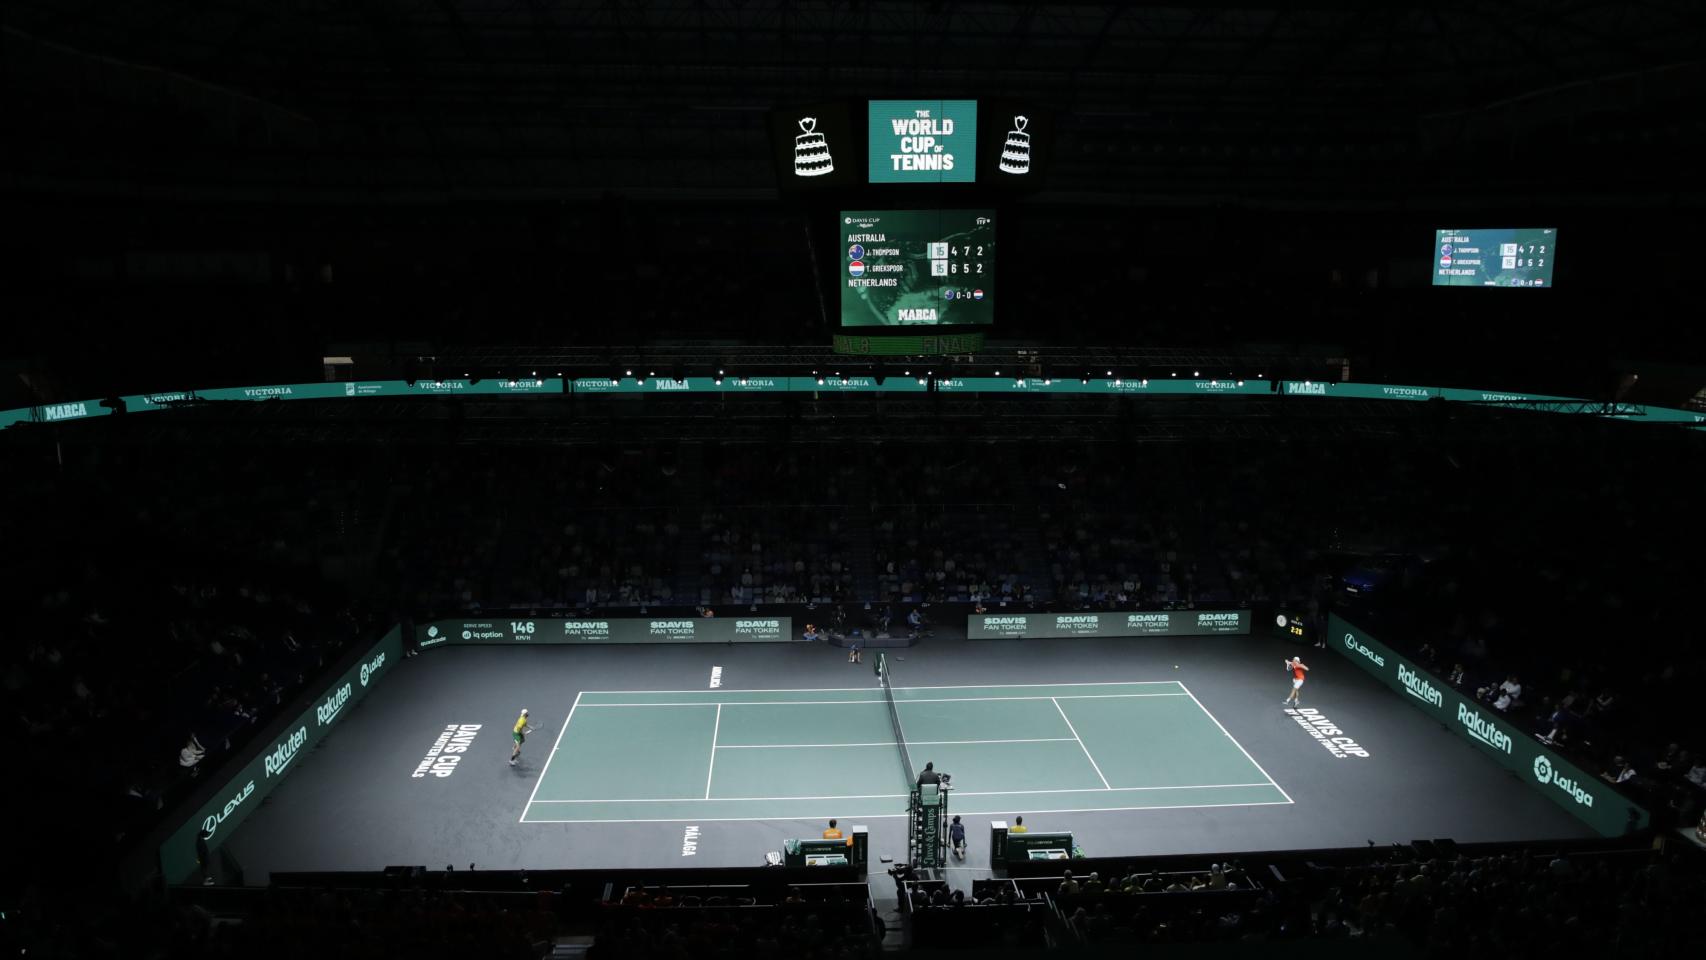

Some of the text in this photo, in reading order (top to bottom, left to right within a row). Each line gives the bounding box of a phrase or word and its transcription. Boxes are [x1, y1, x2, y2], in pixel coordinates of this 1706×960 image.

[915, 110, 930, 118] THE
[892, 119, 954, 135] WORLD
[901, 136, 935, 153] CUP
[891, 154, 954, 171] TENNIS
[848, 234, 886, 242] AUSTRALIA
[873, 248, 900, 256] THOMPSON
[936, 249, 945, 257] 15
[951, 246, 958, 256] 4
[963, 246, 970, 256] 7
[977, 246, 984, 256] 2
[1518, 245, 1525, 253] 4
[1529, 245, 1536, 254] 7
[1539, 245, 1546, 254] 2
[873, 264, 903, 272] GRIEKSPOOR
[936, 265, 945, 274] 15
[951, 263, 957, 273] 6
[963, 263, 970, 273] 5
[976, 263, 983, 273] 2
[1527, 258, 1534, 267] 5
[1538, 258, 1544, 267] 2
[848, 278, 898, 287] NETHERLANDS
[898, 308, 938, 321] MARCA
[499, 380, 542, 389] VITORIA
[655, 379, 690, 390] MARCA
[731, 379, 774, 387] VITORIA
[1288, 381, 1326, 395] MARCA
[244, 387, 293, 397] VICTORIA
[1383, 386, 1428, 397] VICTORIA
[45, 402, 88, 421] MARCA
[510, 621, 536, 634] 146
[480, 631, 503, 641] option
[1355, 640, 1385, 667] LEXUS
[368, 652, 386, 675] LaLiga
[1397, 662, 1443, 708] Rakuten
[316, 682, 352, 726] Rakuten
[1296, 708, 1370, 758] DAVIS CUP
[1457, 702, 1513, 755] Rakuten
[264, 725, 307, 779] Rakuten
[428, 724, 483, 778] DAVIS CUP
[1317, 738, 1348, 759] FINALS
[411, 756, 438, 778] FINALS
[1553, 770, 1594, 808] LaLiga
[216, 780, 255, 824] LEXUS
[924, 808, 938, 835] Camps
[681, 825, 702, 857] MÁLAGA
